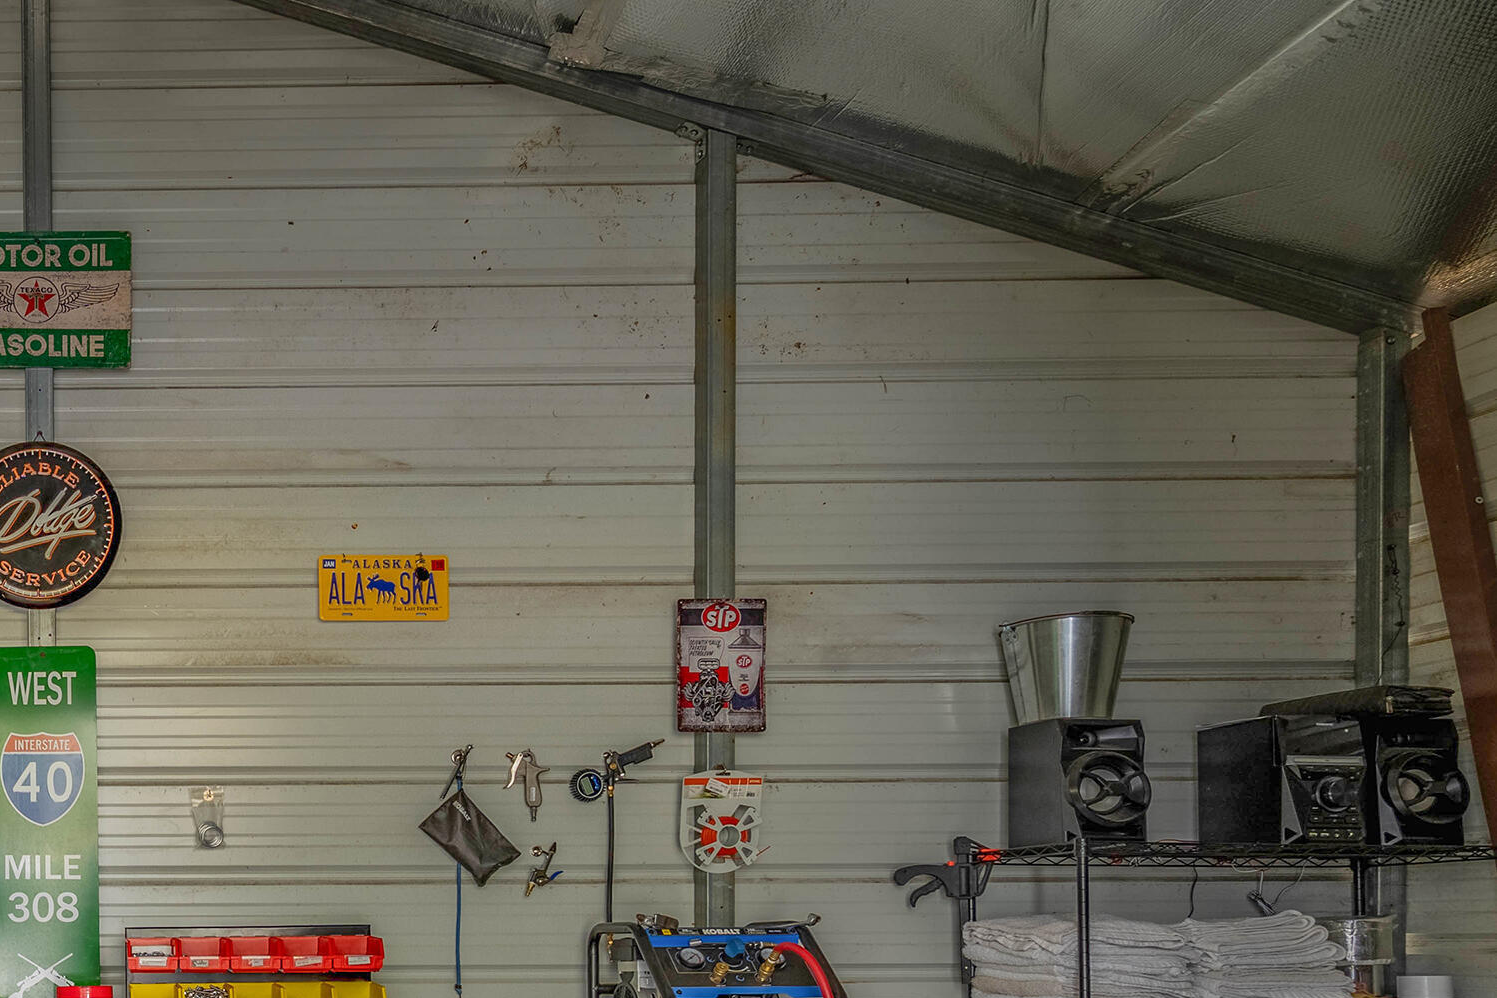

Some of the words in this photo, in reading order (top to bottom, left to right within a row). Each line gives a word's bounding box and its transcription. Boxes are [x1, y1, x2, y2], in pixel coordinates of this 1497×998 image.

[68, 243, 113, 267] OIL
[20, 286, 53, 294] TEXACO
[352, 559, 413, 569] ALASKA
[706, 605, 737, 629] STP
[7, 671, 77, 706] WEST
[14, 738, 70, 751] INTERSTATE
[12, 761, 73, 803] 40
[4, 854, 82, 880] MILE
[7, 891, 79, 923] 308
